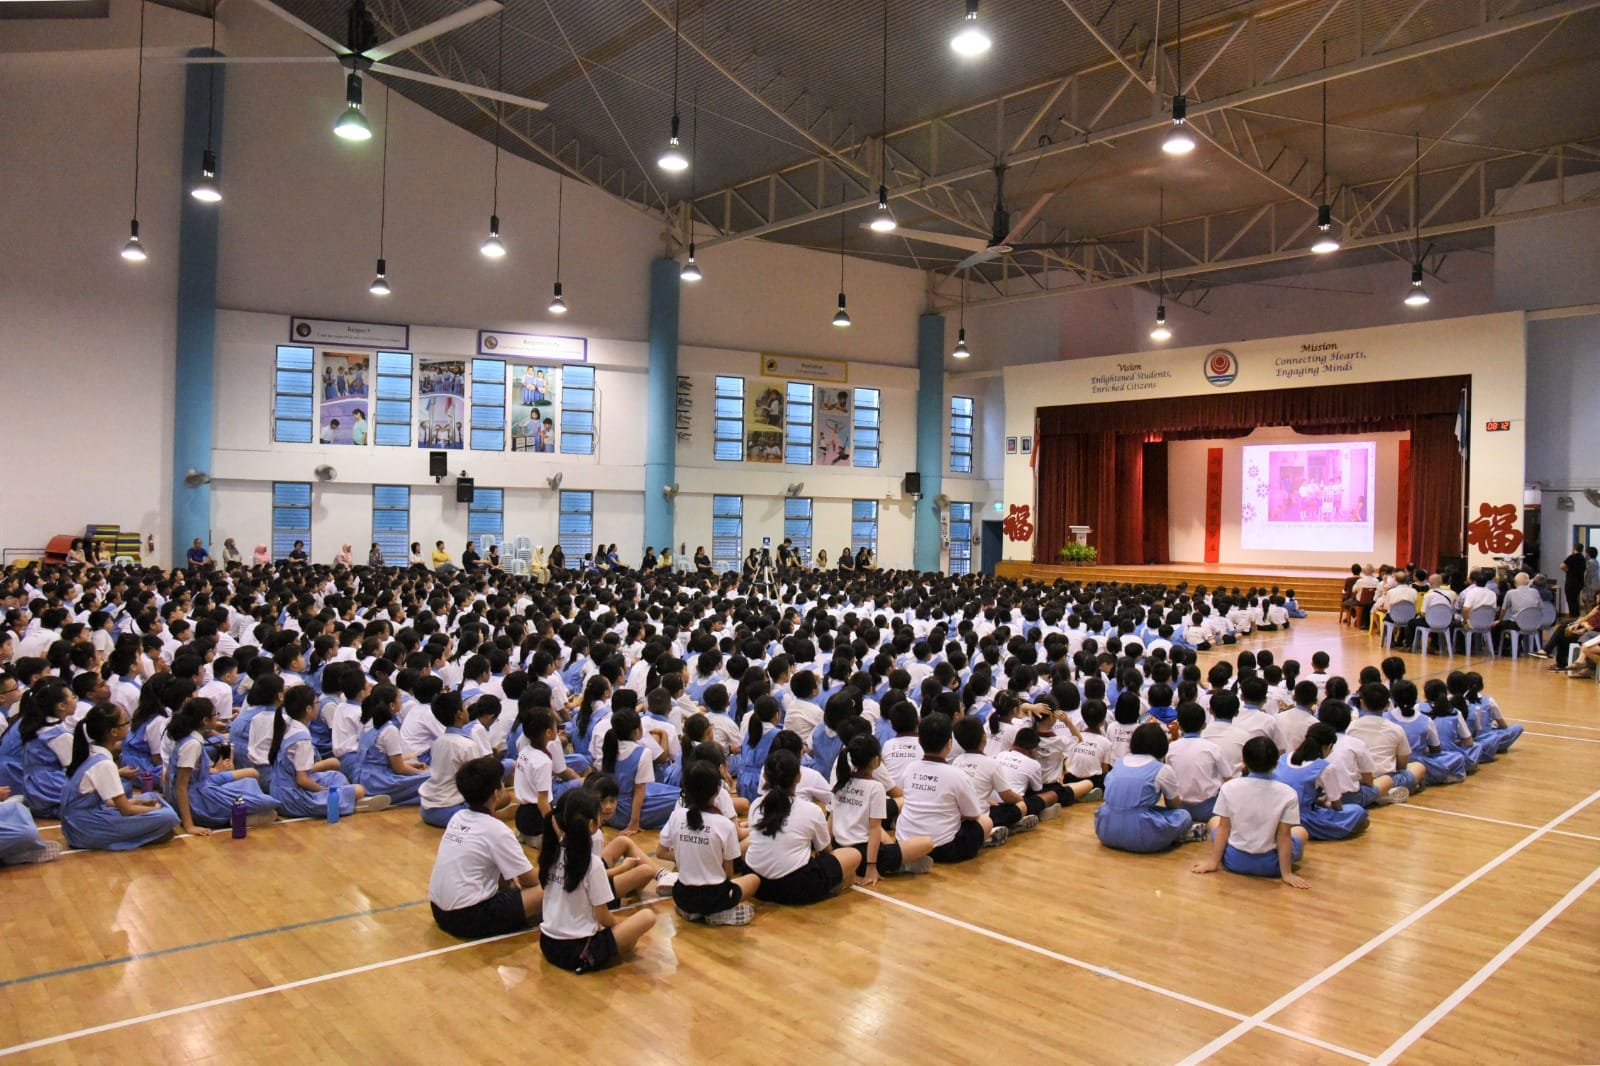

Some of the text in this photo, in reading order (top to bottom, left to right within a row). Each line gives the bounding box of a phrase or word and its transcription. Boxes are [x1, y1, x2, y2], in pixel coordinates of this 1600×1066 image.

[1300, 343, 1338, 352] Mission
[1275, 351, 1367, 365] Connecting Hearts,
[1117, 363, 1142, 372] Vision
[1276, 362, 1353, 378] Engaging Minds
[1091, 370, 1172, 384] Enlightened Students,
[1092, 381, 1157, 393] Enriched Citizens
[1003, 503, 1034, 542] 福
[1467, 502, 1524, 555] 福
[911, 782, 937, 792] KEMING
